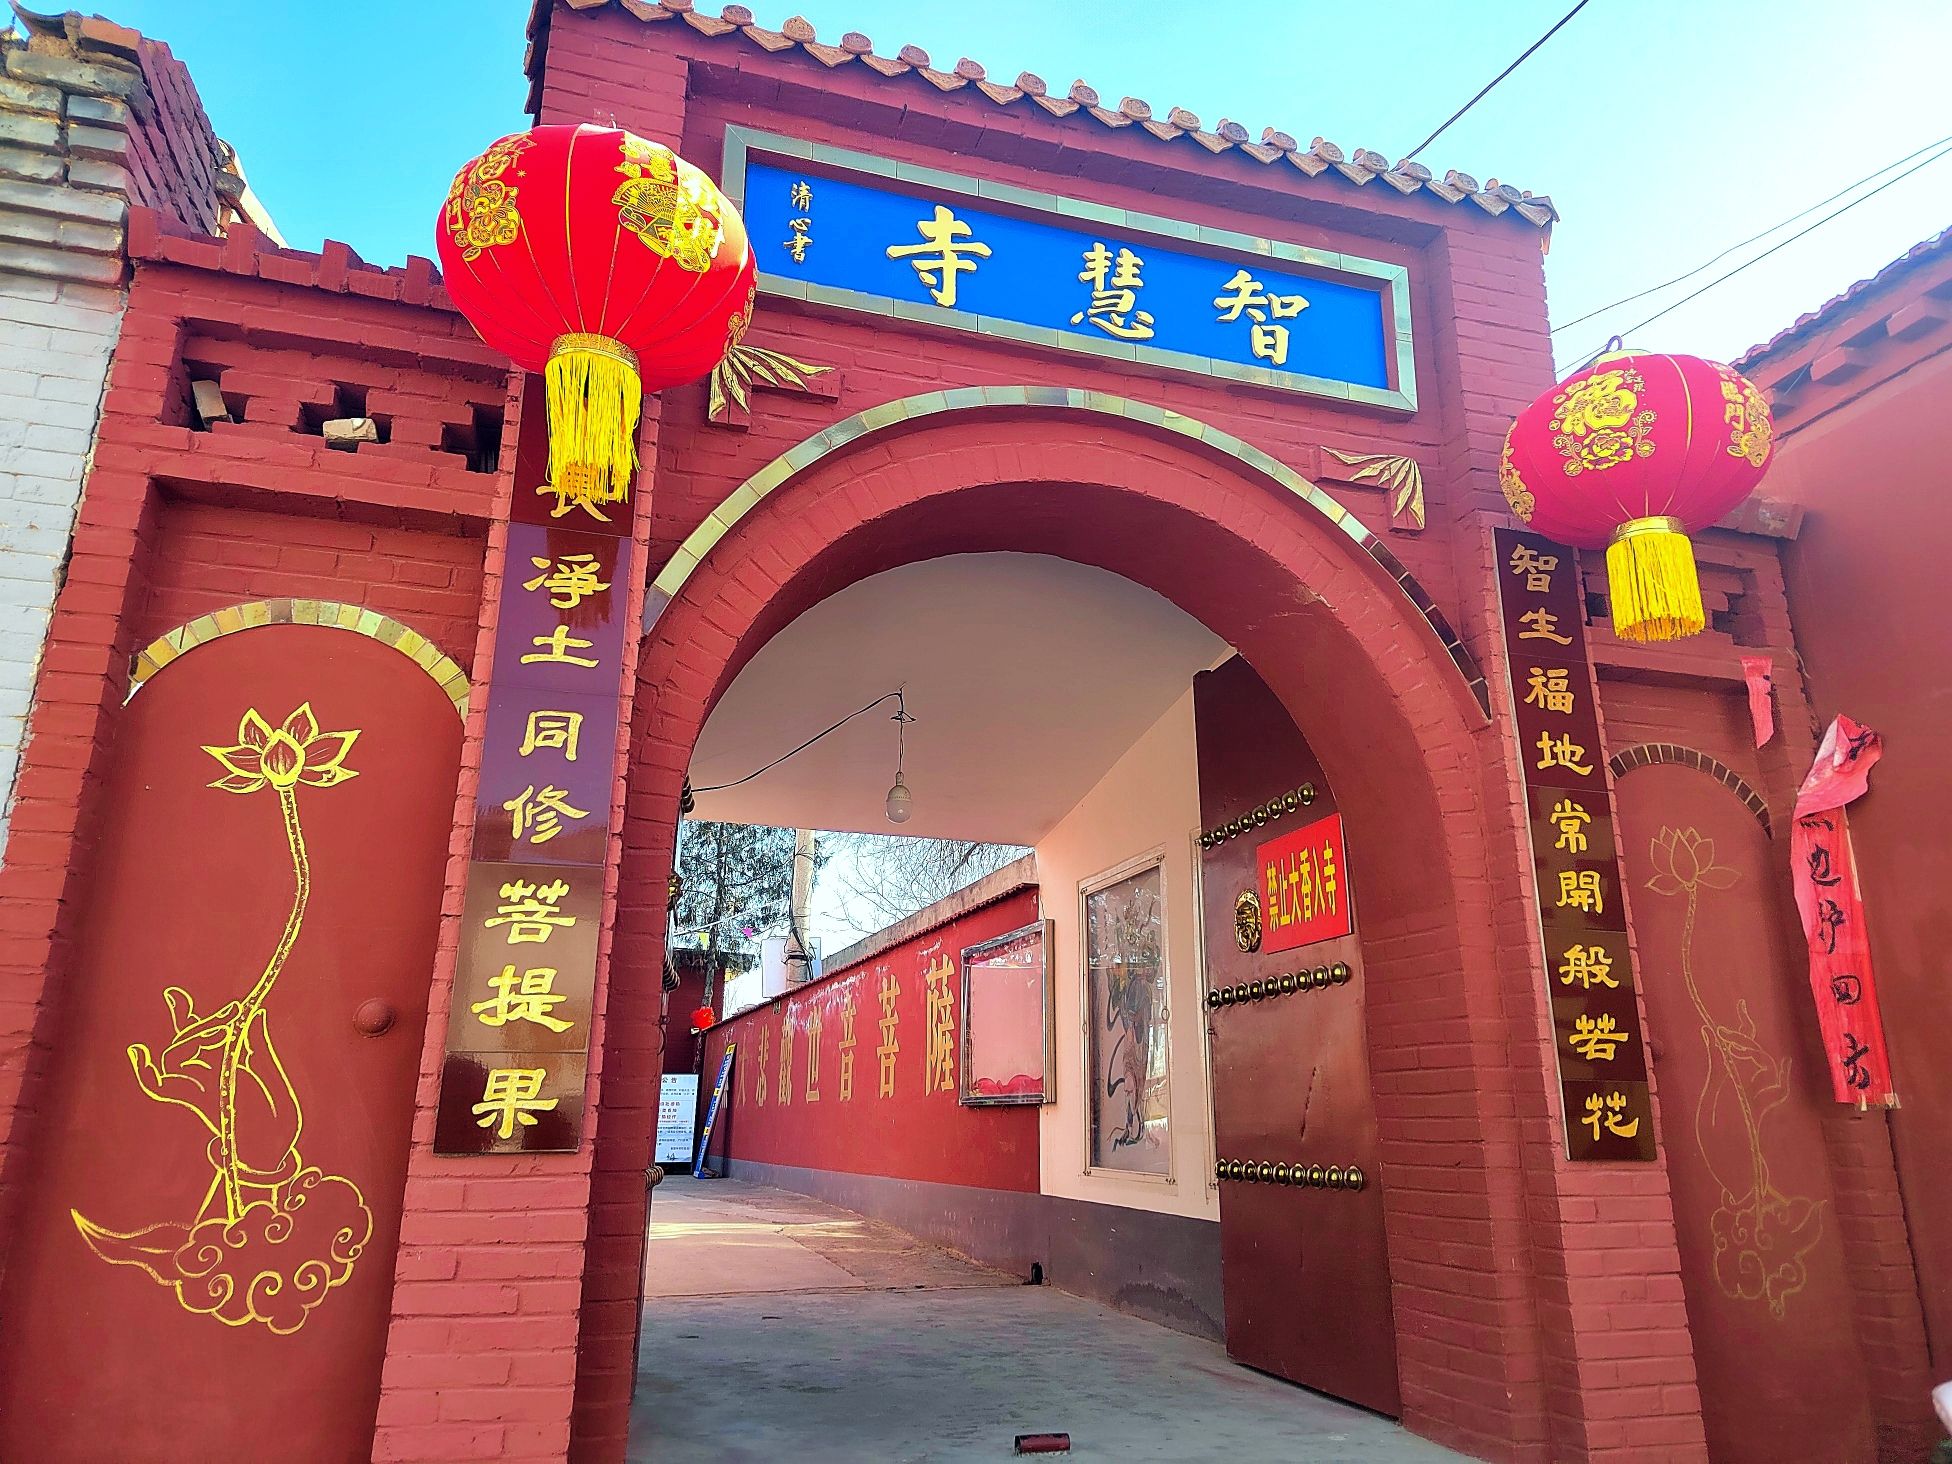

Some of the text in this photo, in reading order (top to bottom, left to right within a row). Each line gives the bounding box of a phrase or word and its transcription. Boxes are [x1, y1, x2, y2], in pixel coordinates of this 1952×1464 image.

[886, 205, 1310, 365] 智慧寺
[1266, 839, 1336, 932] 禁止大香入寺
[1509, 544, 1640, 1141] 智生福地常開般若花
[721, 954, 955, 1107] 大悲觀世音菩薩
